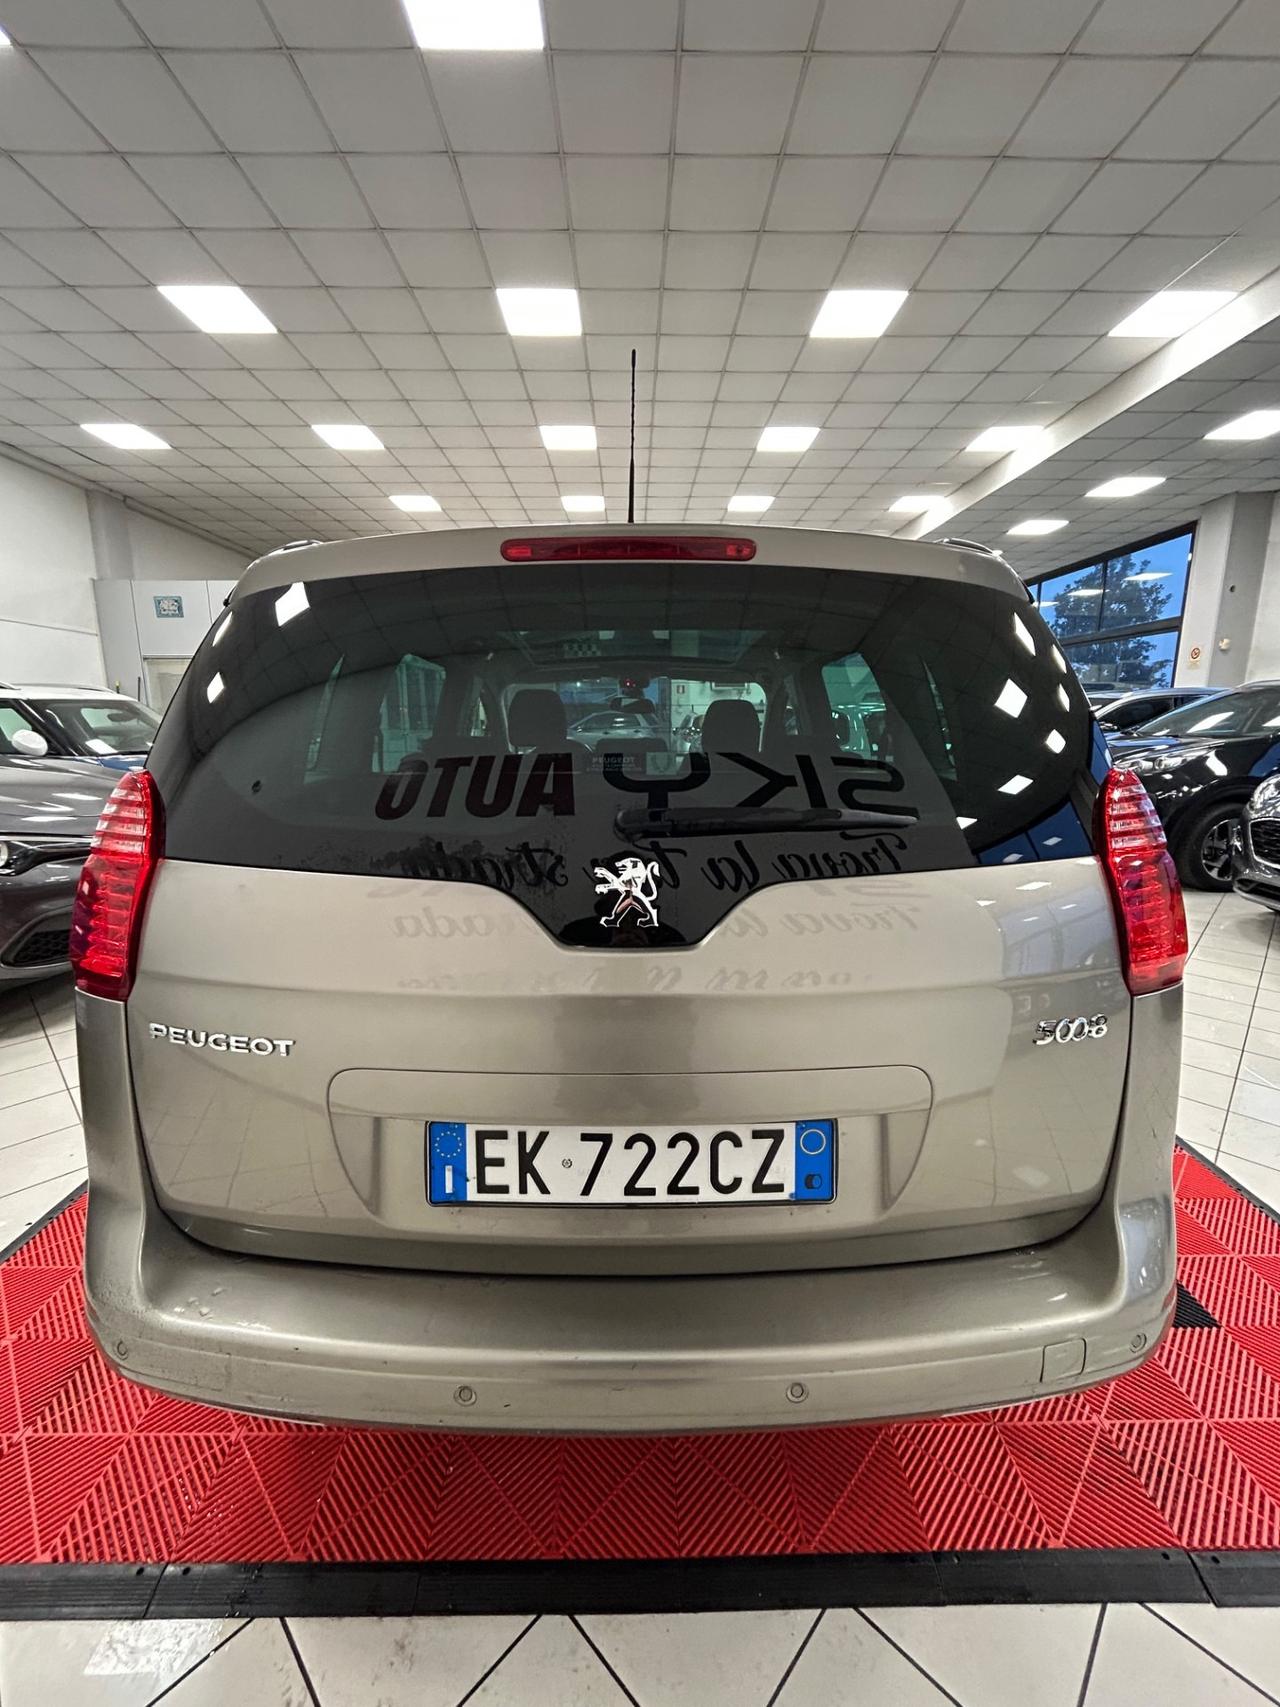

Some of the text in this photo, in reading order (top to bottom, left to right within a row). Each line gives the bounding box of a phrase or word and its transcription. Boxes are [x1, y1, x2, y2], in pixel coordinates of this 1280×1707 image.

[149, 1022, 295, 1057] PEUGEOT
[1033, 1013, 1108, 1045] 5008
[475, 1129, 785, 1197] EK 722CZ
